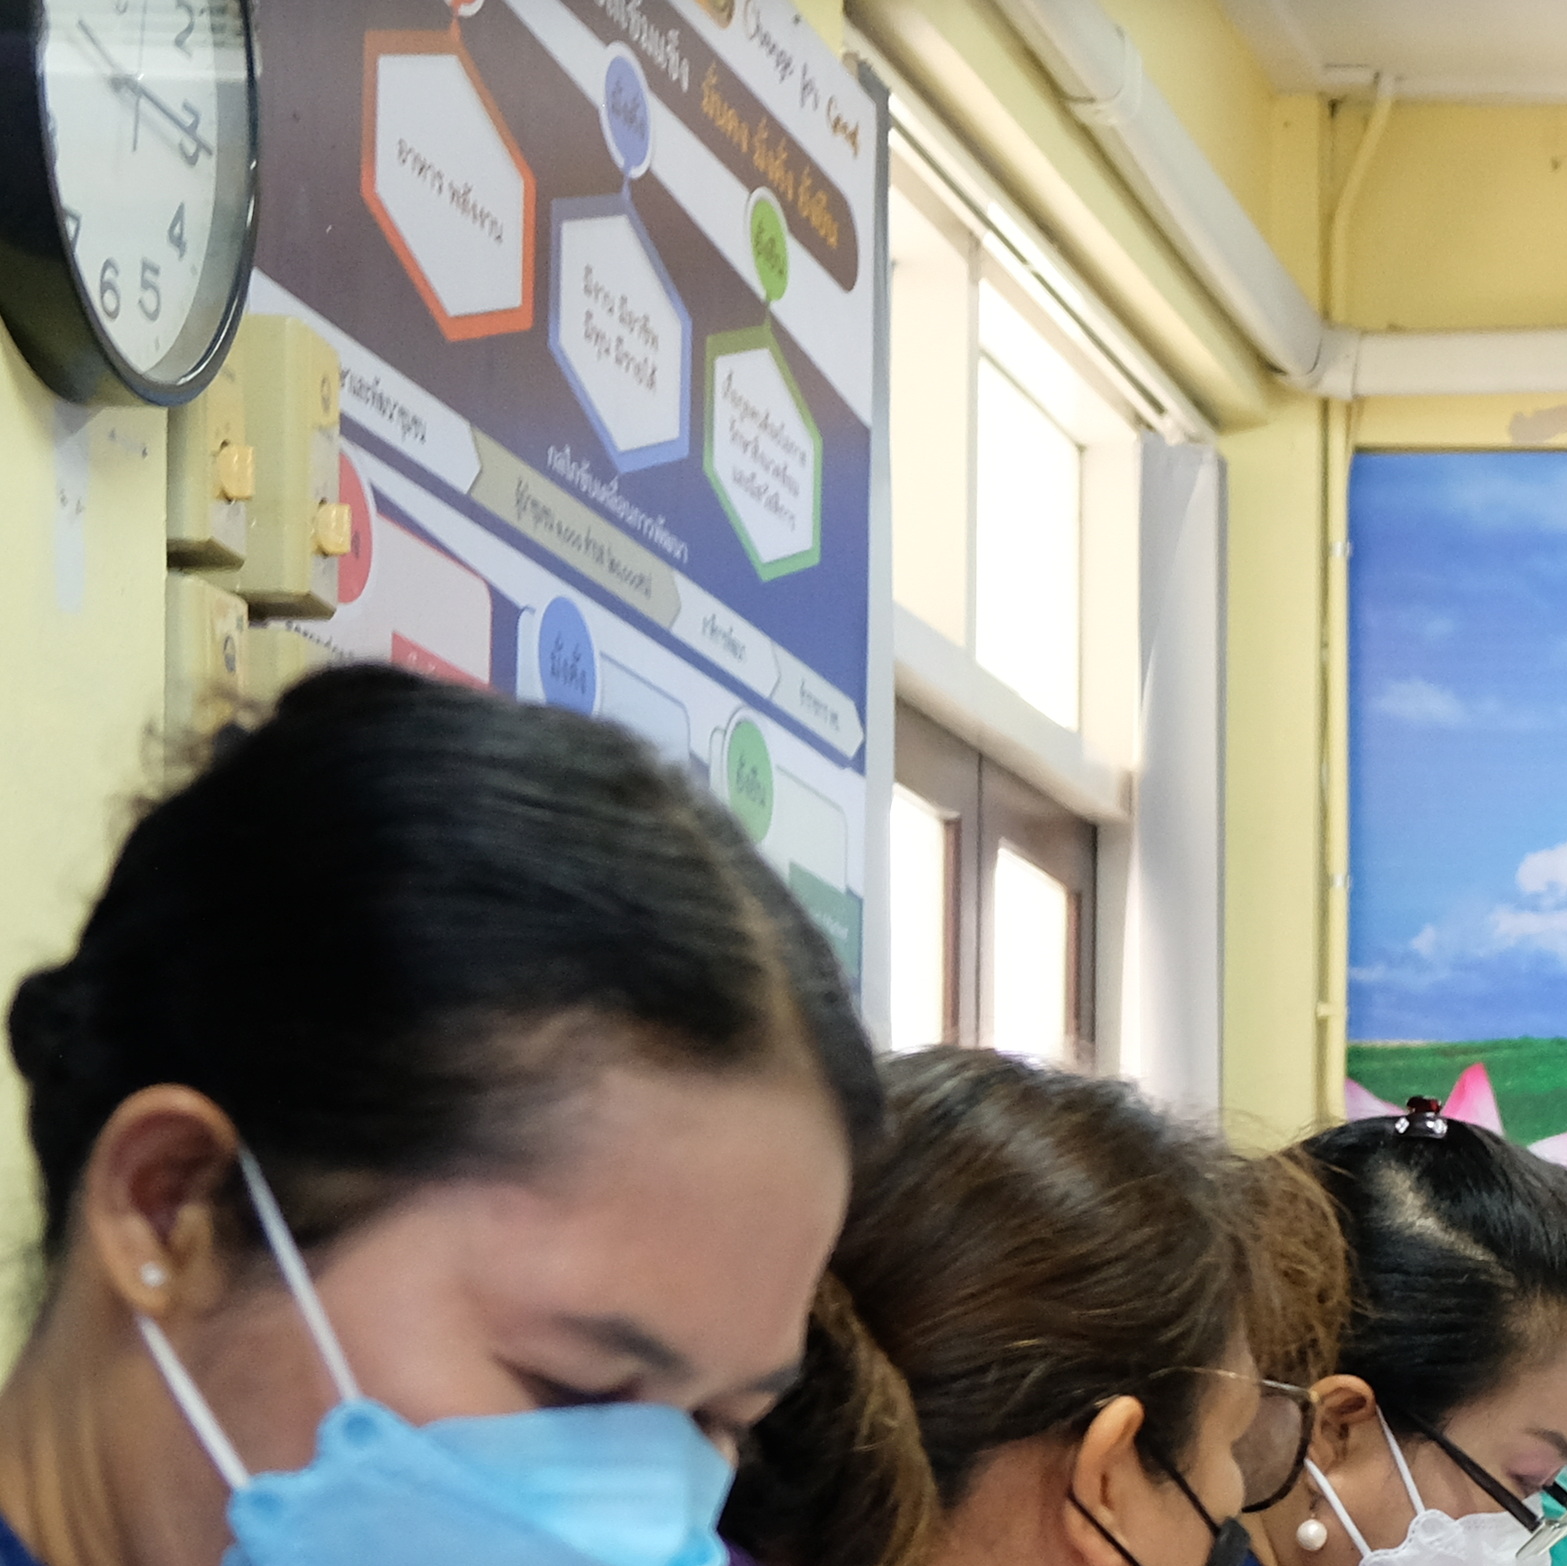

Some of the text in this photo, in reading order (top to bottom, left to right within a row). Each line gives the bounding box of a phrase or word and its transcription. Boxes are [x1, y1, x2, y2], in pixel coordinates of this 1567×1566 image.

[168, 202, 188, 260] 4
[101, 257, 121, 322] 6
[138, 256, 162, 323] 5
